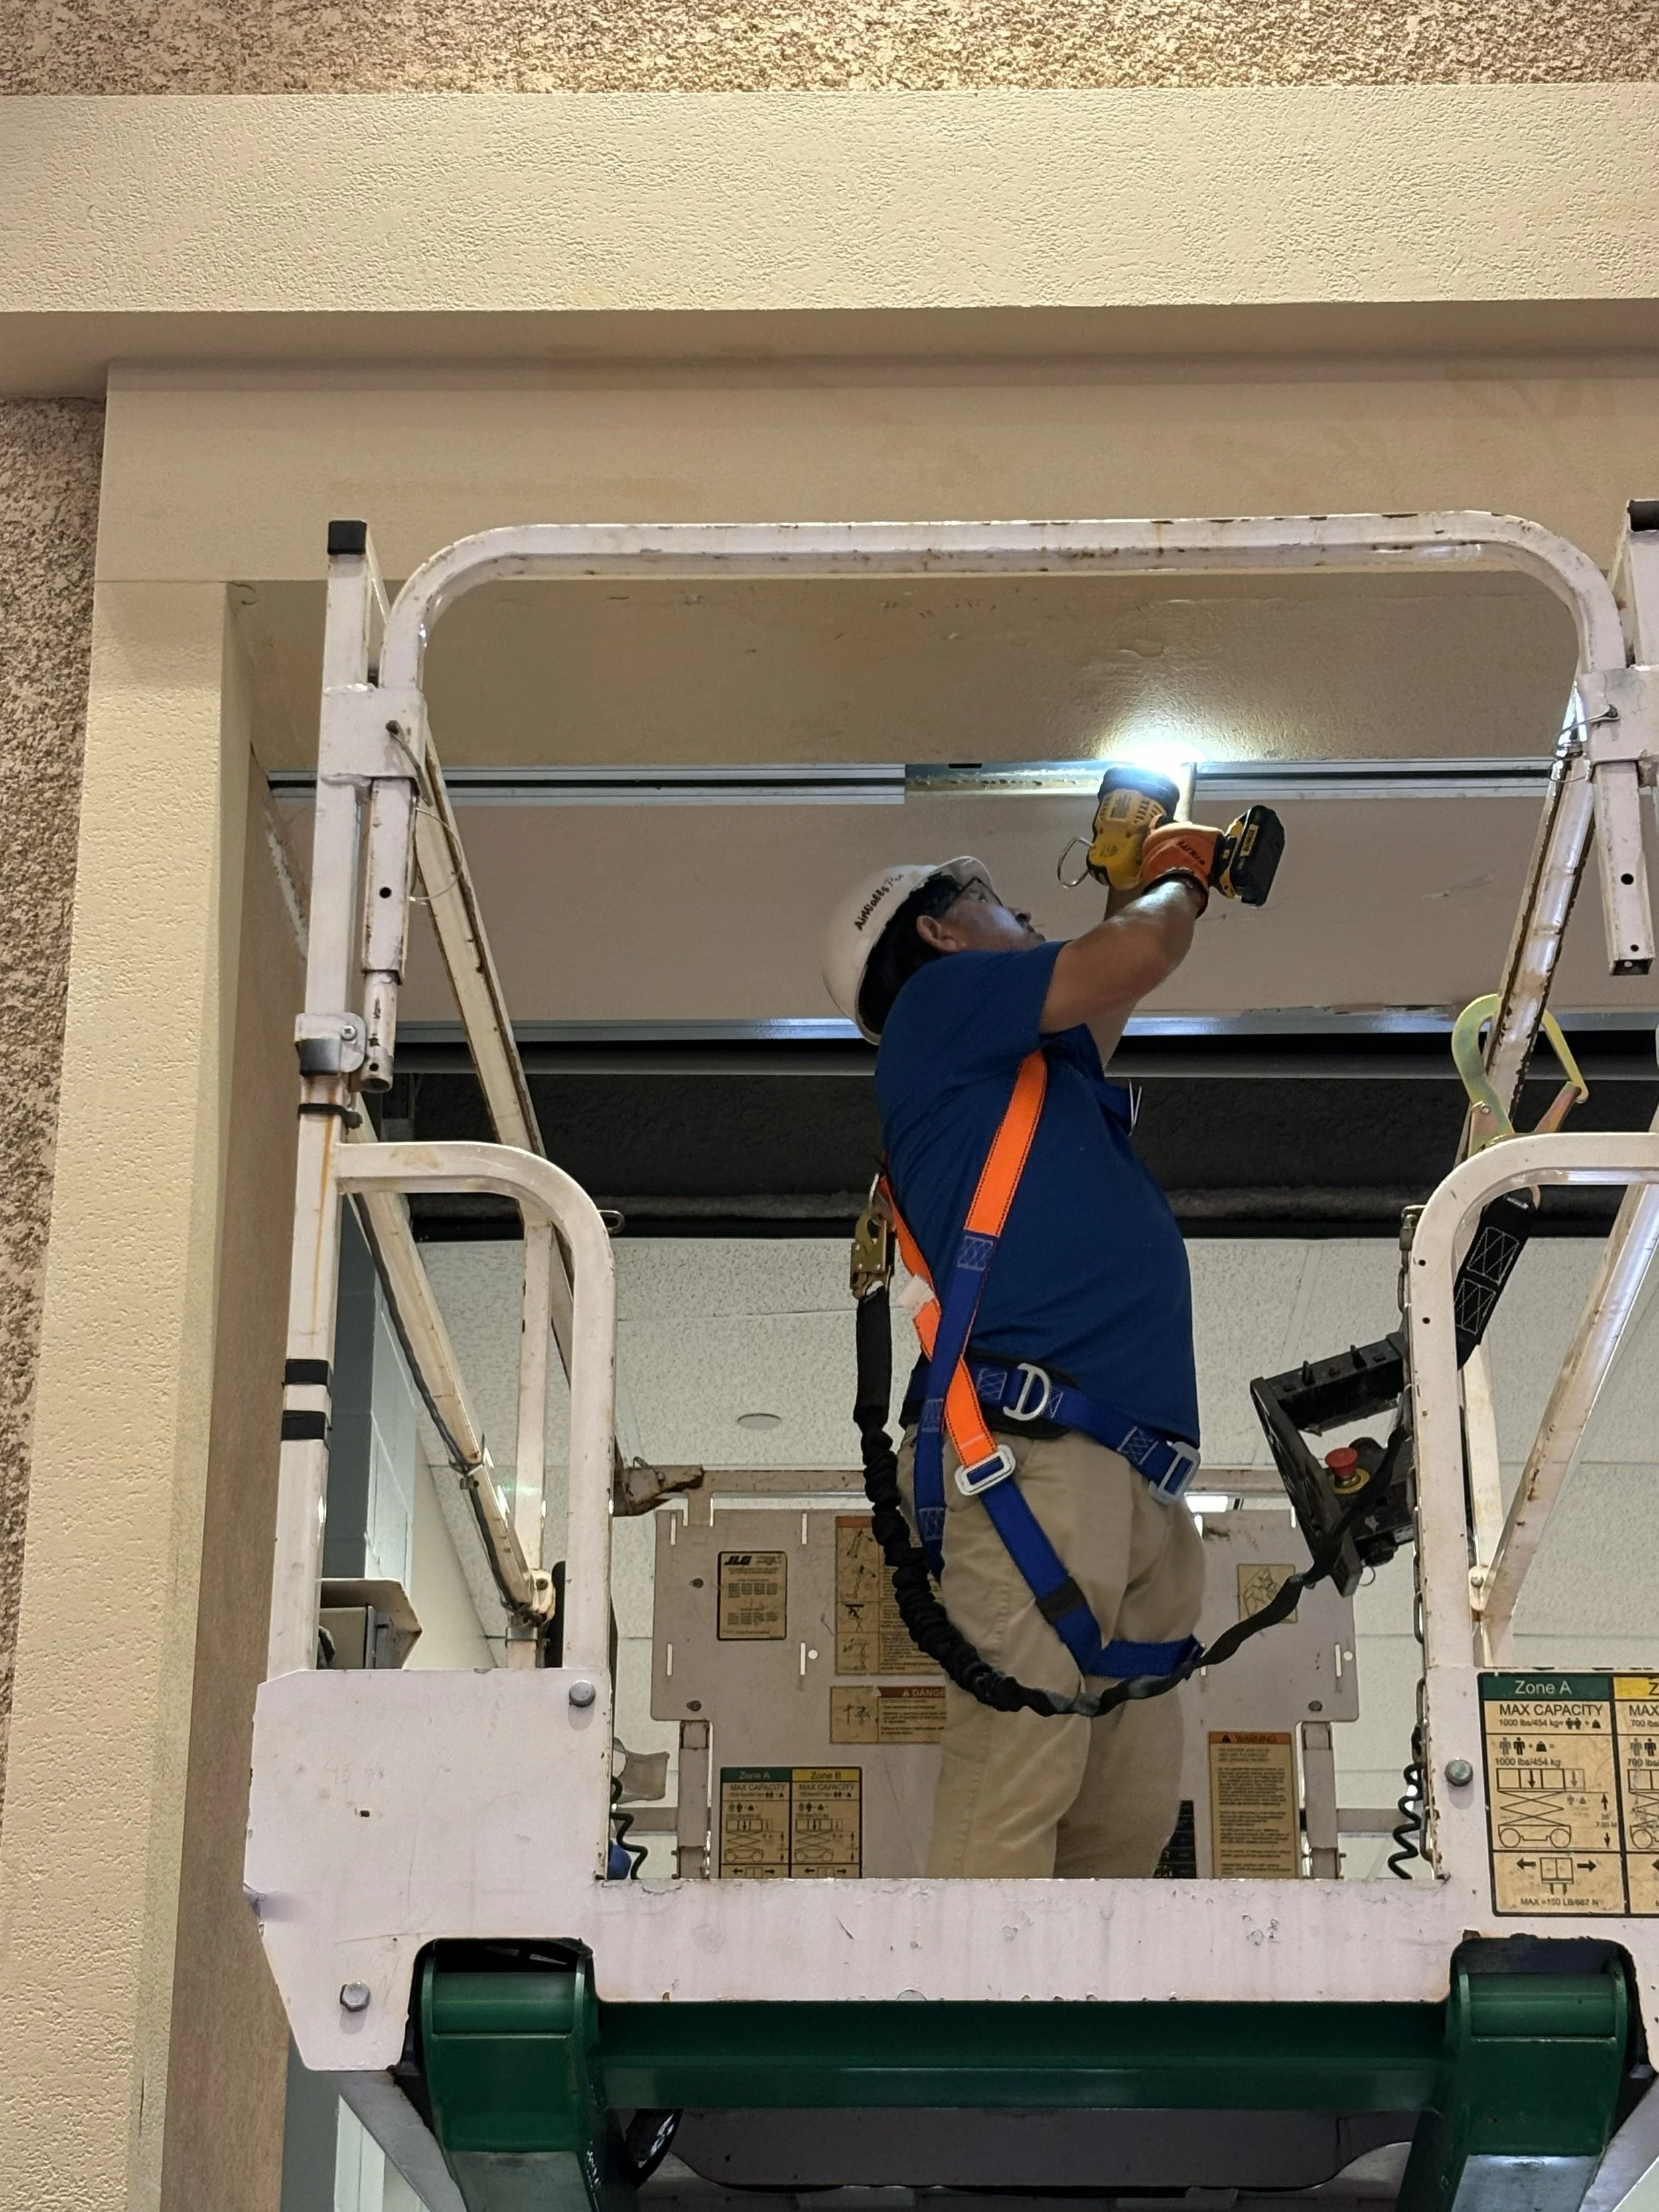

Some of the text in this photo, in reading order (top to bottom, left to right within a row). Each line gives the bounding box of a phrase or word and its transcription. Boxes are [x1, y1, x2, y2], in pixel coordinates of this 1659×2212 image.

[1514, 1680, 1572, 1694] Zone A
[1499, 1704, 1603, 1716] MAX CAPACITY
[1628, 1704, 1659, 1717] MAX
[1495, 1757, 1561, 1769] 1000 lbs/454 kg
[1627, 1758, 1643, 1767] 700
[739, 1771, 770, 1780] Zone A
[835, 1771, 841, 1780] B
